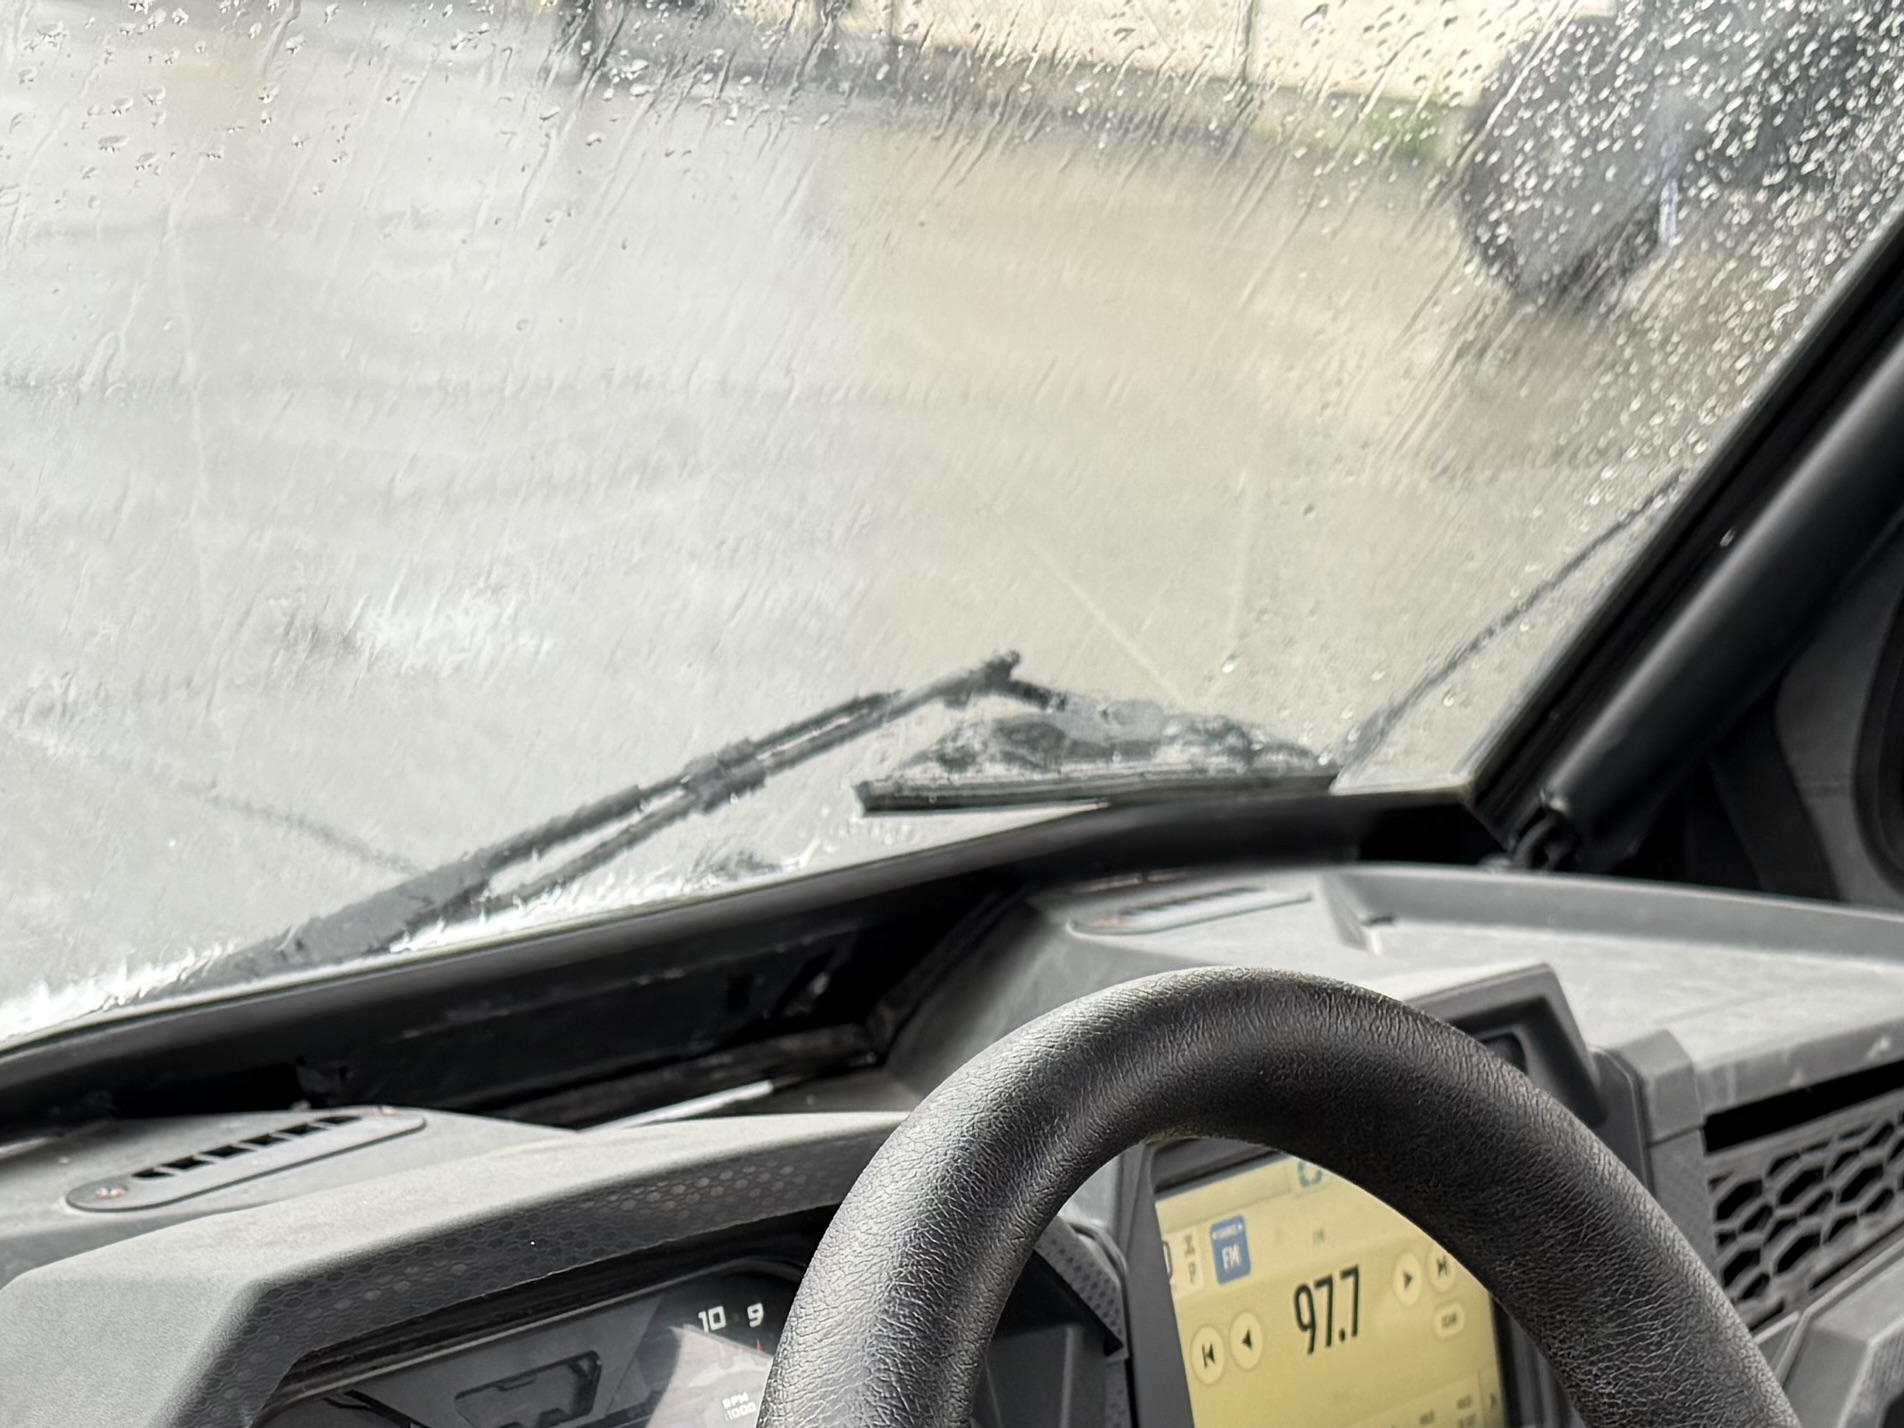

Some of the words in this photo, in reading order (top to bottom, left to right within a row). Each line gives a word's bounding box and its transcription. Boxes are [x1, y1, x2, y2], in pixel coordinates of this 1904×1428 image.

[698, 1305, 727, 1333] 10
[747, 1302, 764, 1328] 9
[1293, 1264, 1361, 1356] 97.7
